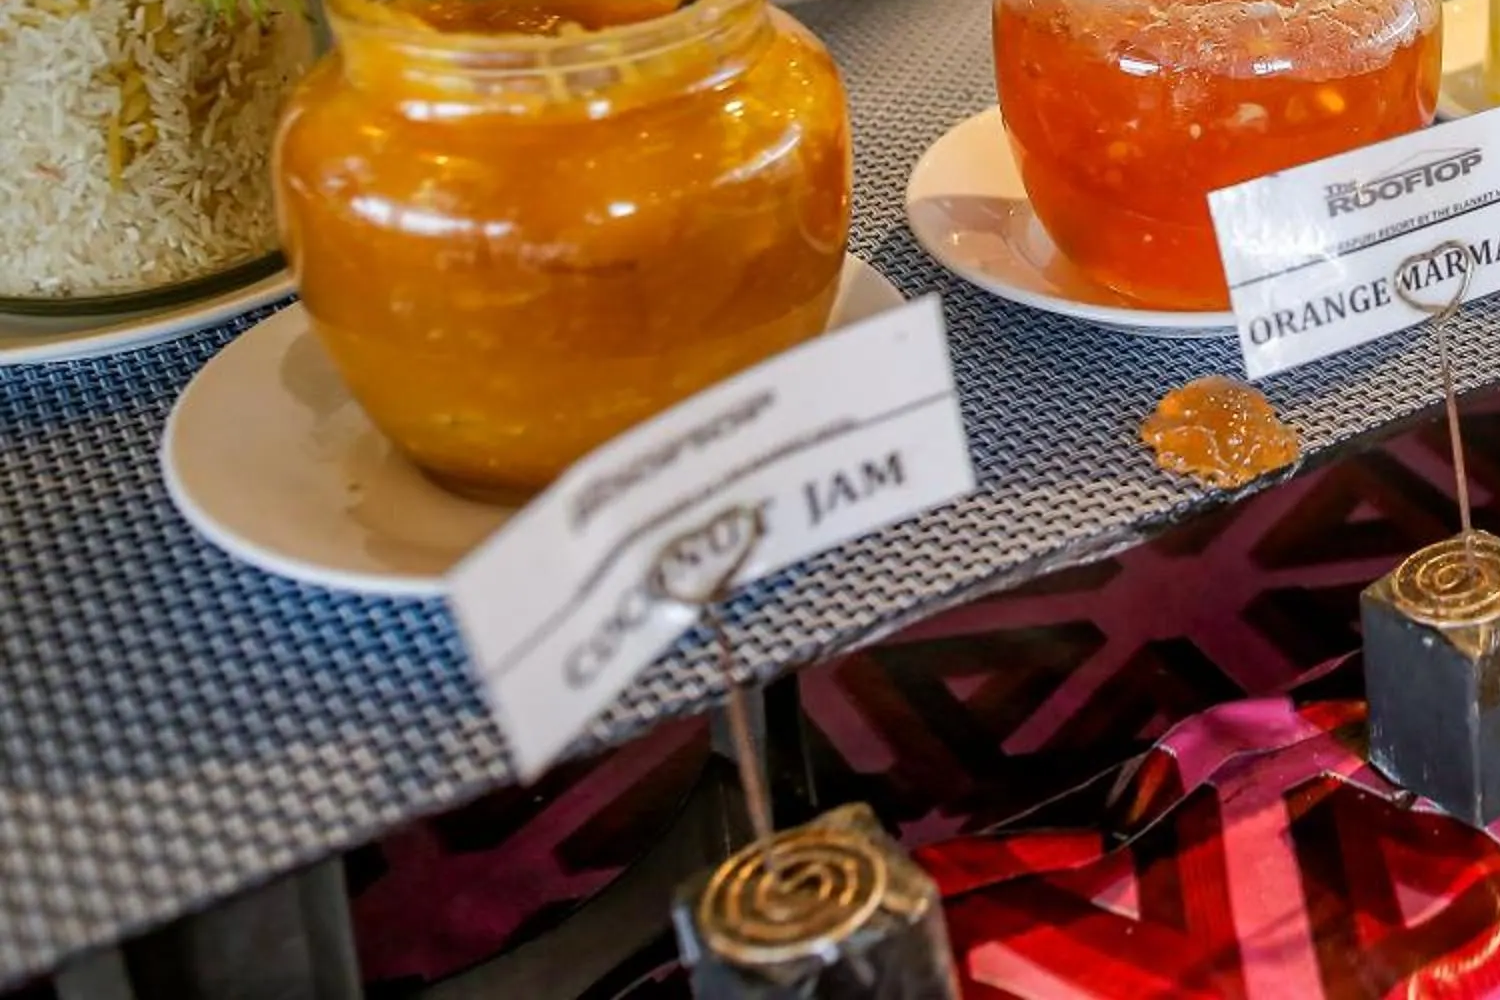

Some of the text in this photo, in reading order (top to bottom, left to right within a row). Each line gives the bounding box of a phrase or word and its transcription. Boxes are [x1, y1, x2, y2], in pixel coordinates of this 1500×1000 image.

[1327, 152, 1483, 217] ROOFTOP
[1249, 276, 1391, 346] ORANGE
[562, 496, 776, 690] COCNU
[803, 450, 906, 525] JAM
